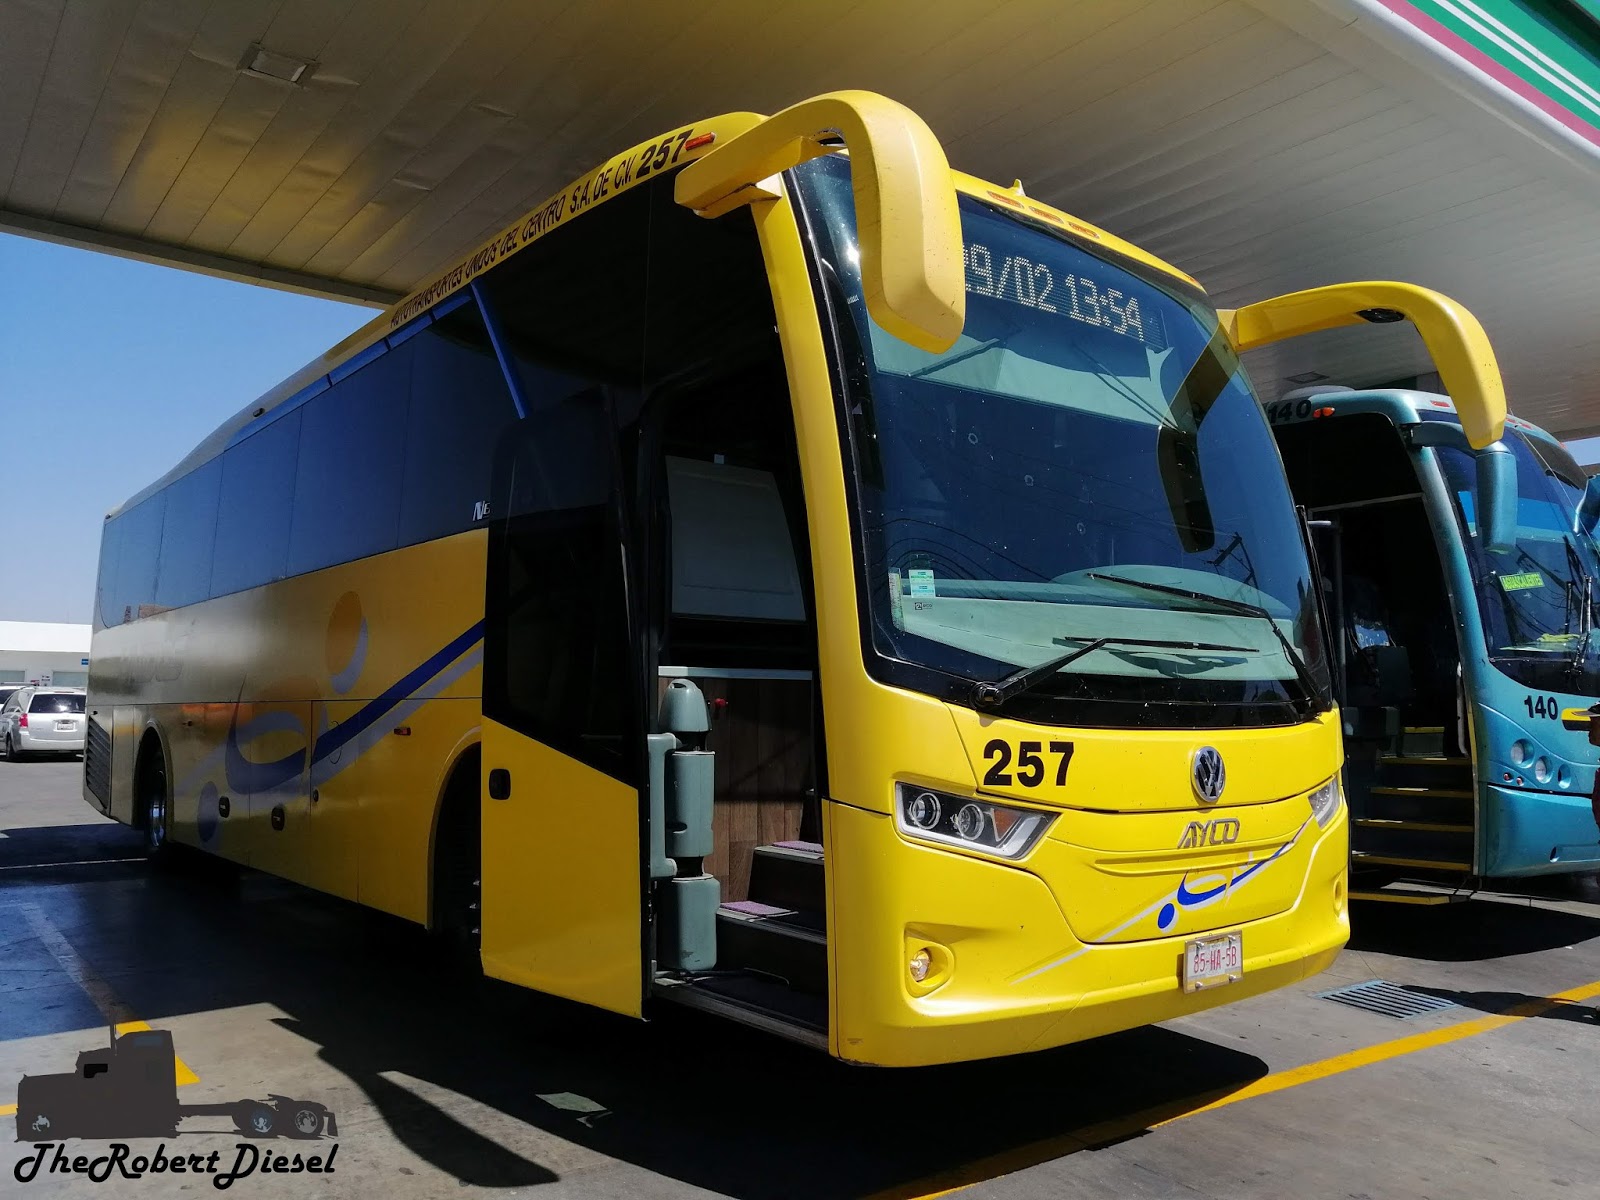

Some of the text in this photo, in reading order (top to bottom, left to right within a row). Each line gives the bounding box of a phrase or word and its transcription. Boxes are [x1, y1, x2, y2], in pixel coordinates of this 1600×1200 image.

[465, 238, 502, 279] UNIDOS
[500, 224, 521, 257] DEL
[522, 194, 567, 242] CENTRO
[569, 179, 591, 213] S.A.
[593, 167, 613, 201] DE
[614, 153, 638, 189] C.V.
[636, 128, 694, 179] 257
[962, 243, 1145, 342] 9/02 13:54
[1267, 400, 1312, 424] 140
[1524, 695, 1559, 721] 140
[982, 738, 1075, 788] 257
[1177, 817, 1240, 849] AYCO
[1193, 946, 1237, 974] 85-HA-5B
